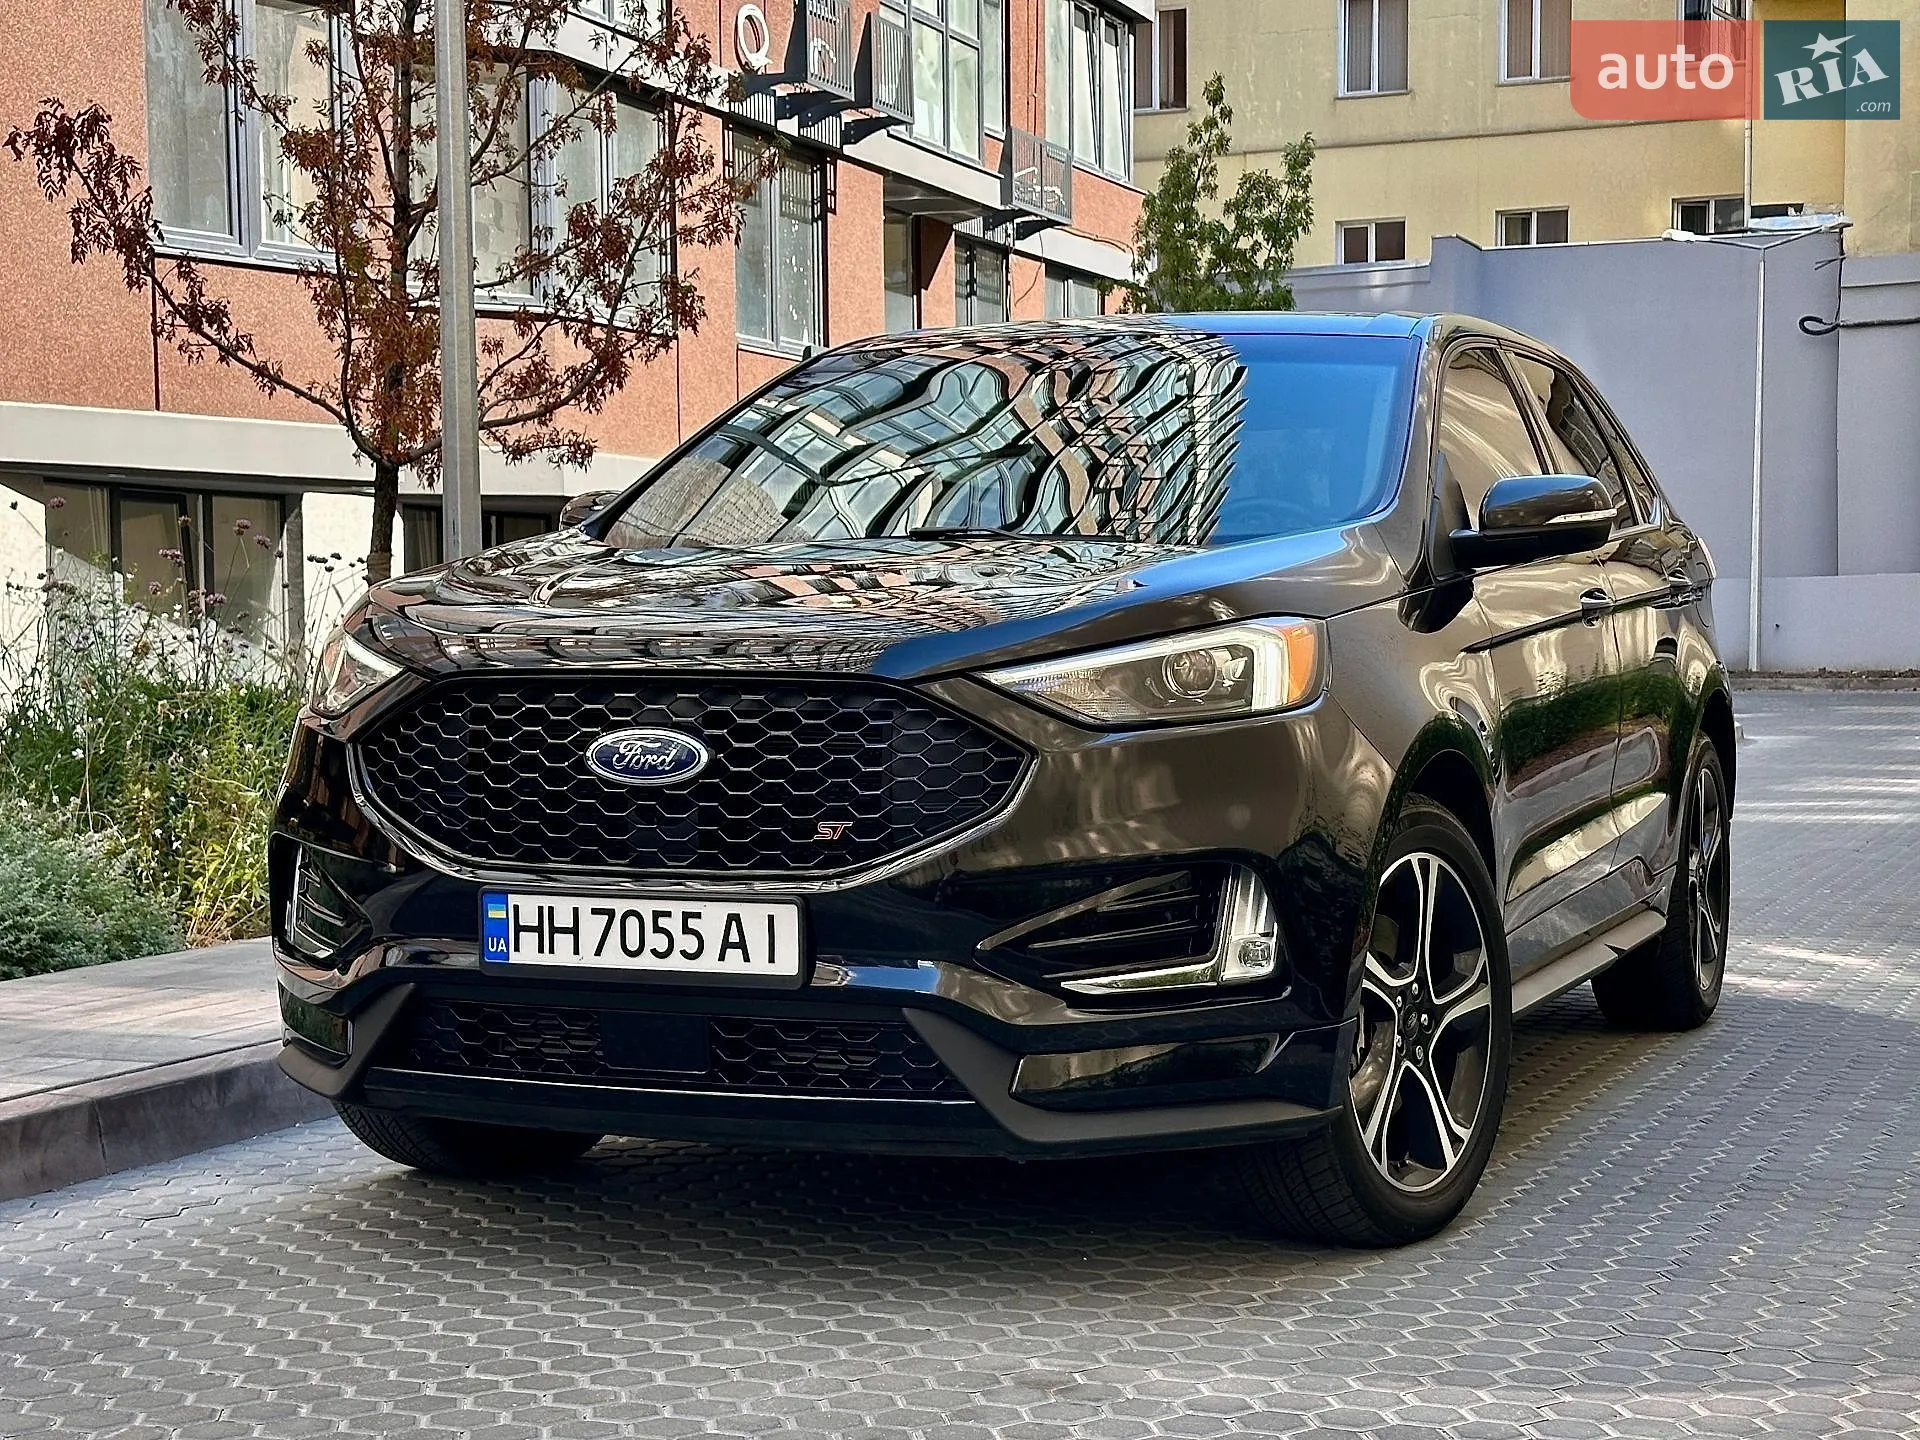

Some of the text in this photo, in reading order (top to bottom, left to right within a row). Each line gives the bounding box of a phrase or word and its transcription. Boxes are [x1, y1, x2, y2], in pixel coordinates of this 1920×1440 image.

[612, 740, 681, 770] Ford
[814, 821, 853, 840] ST
[488, 937, 507, 953] UA
